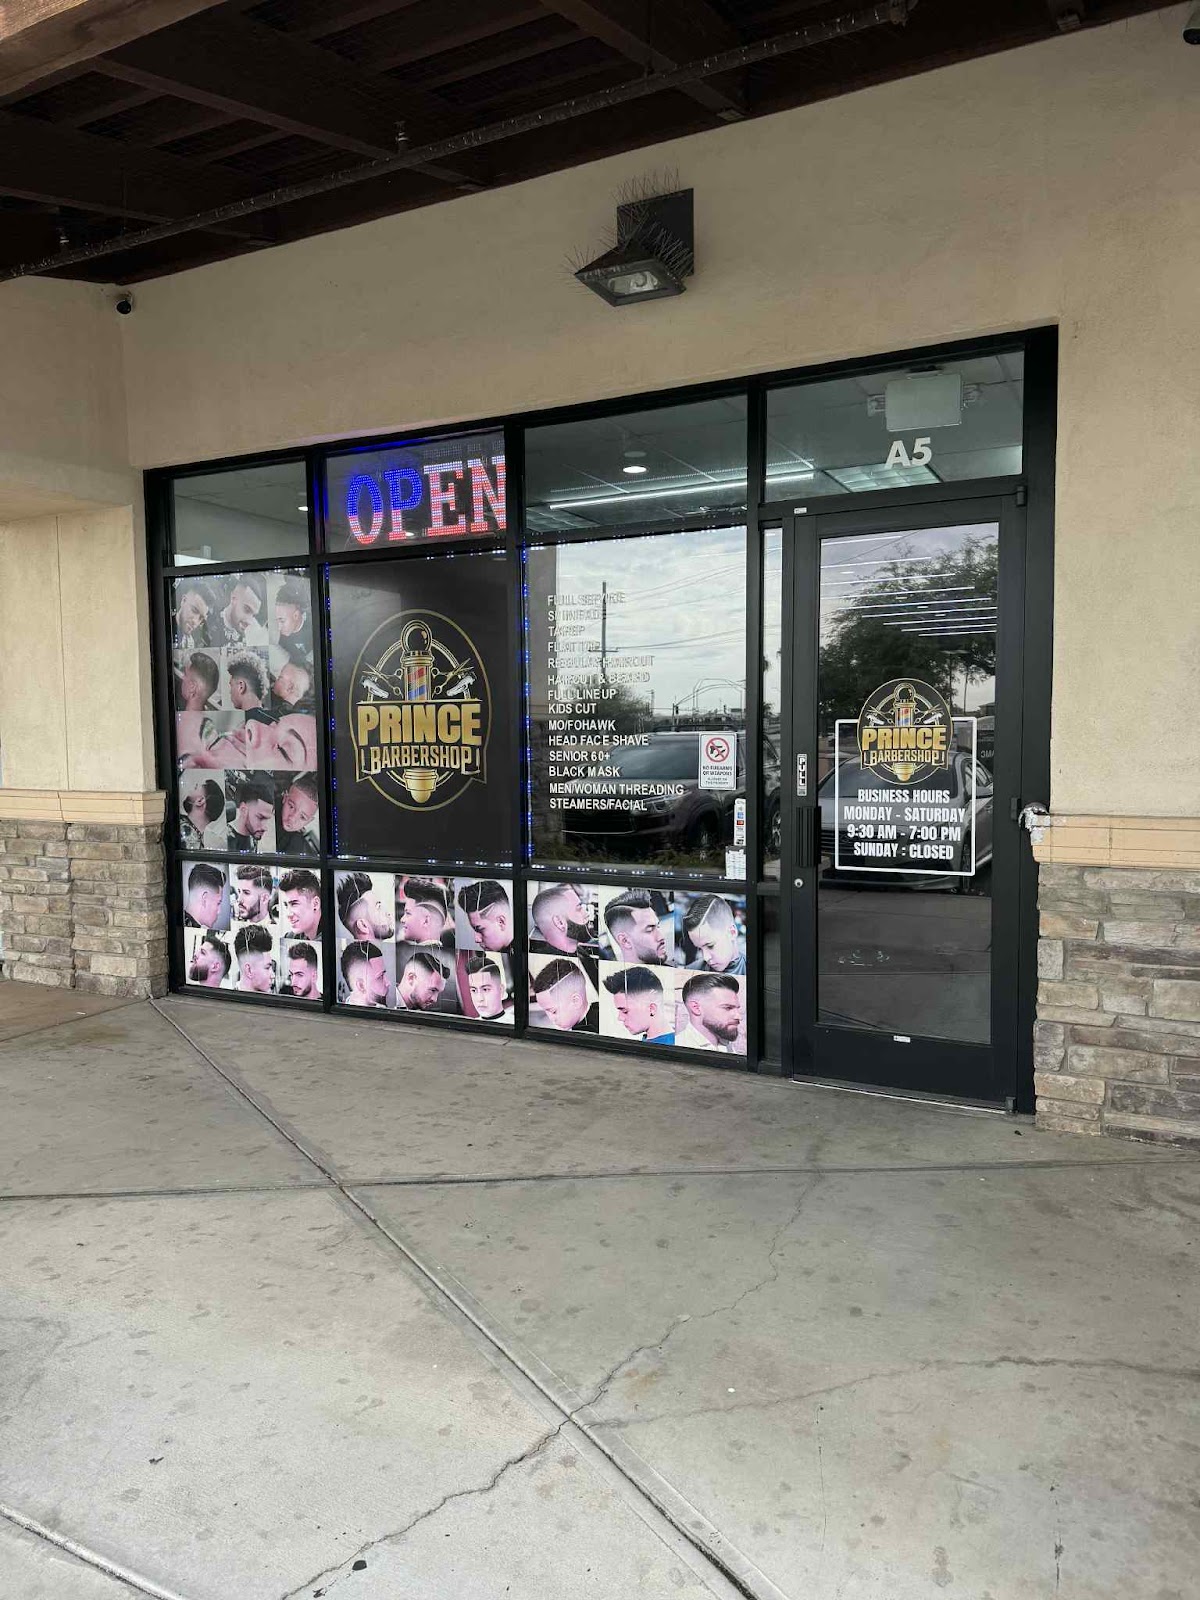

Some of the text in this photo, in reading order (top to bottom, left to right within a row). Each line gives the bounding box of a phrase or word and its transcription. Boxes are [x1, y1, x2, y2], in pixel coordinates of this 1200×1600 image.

[884, 437, 932, 469] A5
[347, 455, 507, 545] OPEN
[547, 594, 577, 606] FULL
[547, 673, 593, 685] HAIRCUT
[609, 671, 651, 683] BEARD
[547, 689, 577, 700] FULL
[548, 703, 597, 714] KIDS CUT
[357, 703, 482, 746] PRINCE
[548, 719, 616, 731] MO/FOHAWK
[548, 734, 649, 746] HEAD FACE SHAVE
[861, 727, 947, 751] PRINCE
[370, 745, 472, 775] BARBERSHOP
[549, 750, 611, 762] SENIOR 60+
[869, 749, 941, 767] BARBERSHOP
[548, 766, 620, 777] BLACK MASK
[549, 783, 684, 796] MEN/WOMAN THREADING
[857, 789, 950, 804] BUSINESS HOURS
[549, 798, 648, 811] STEAMERS/FACIAL
[843, 806, 893, 821] MONDAY
[904, 807, 966, 823] SATURDAY
[847, 823, 874, 838] 9:30
[877, 824, 897, 840] AM
[909, 825, 937, 840] 7:00
[940, 826, 961, 842] PM
[853, 842, 899, 858] SUNDAY
[909, 843, 954, 860] CLOSED
